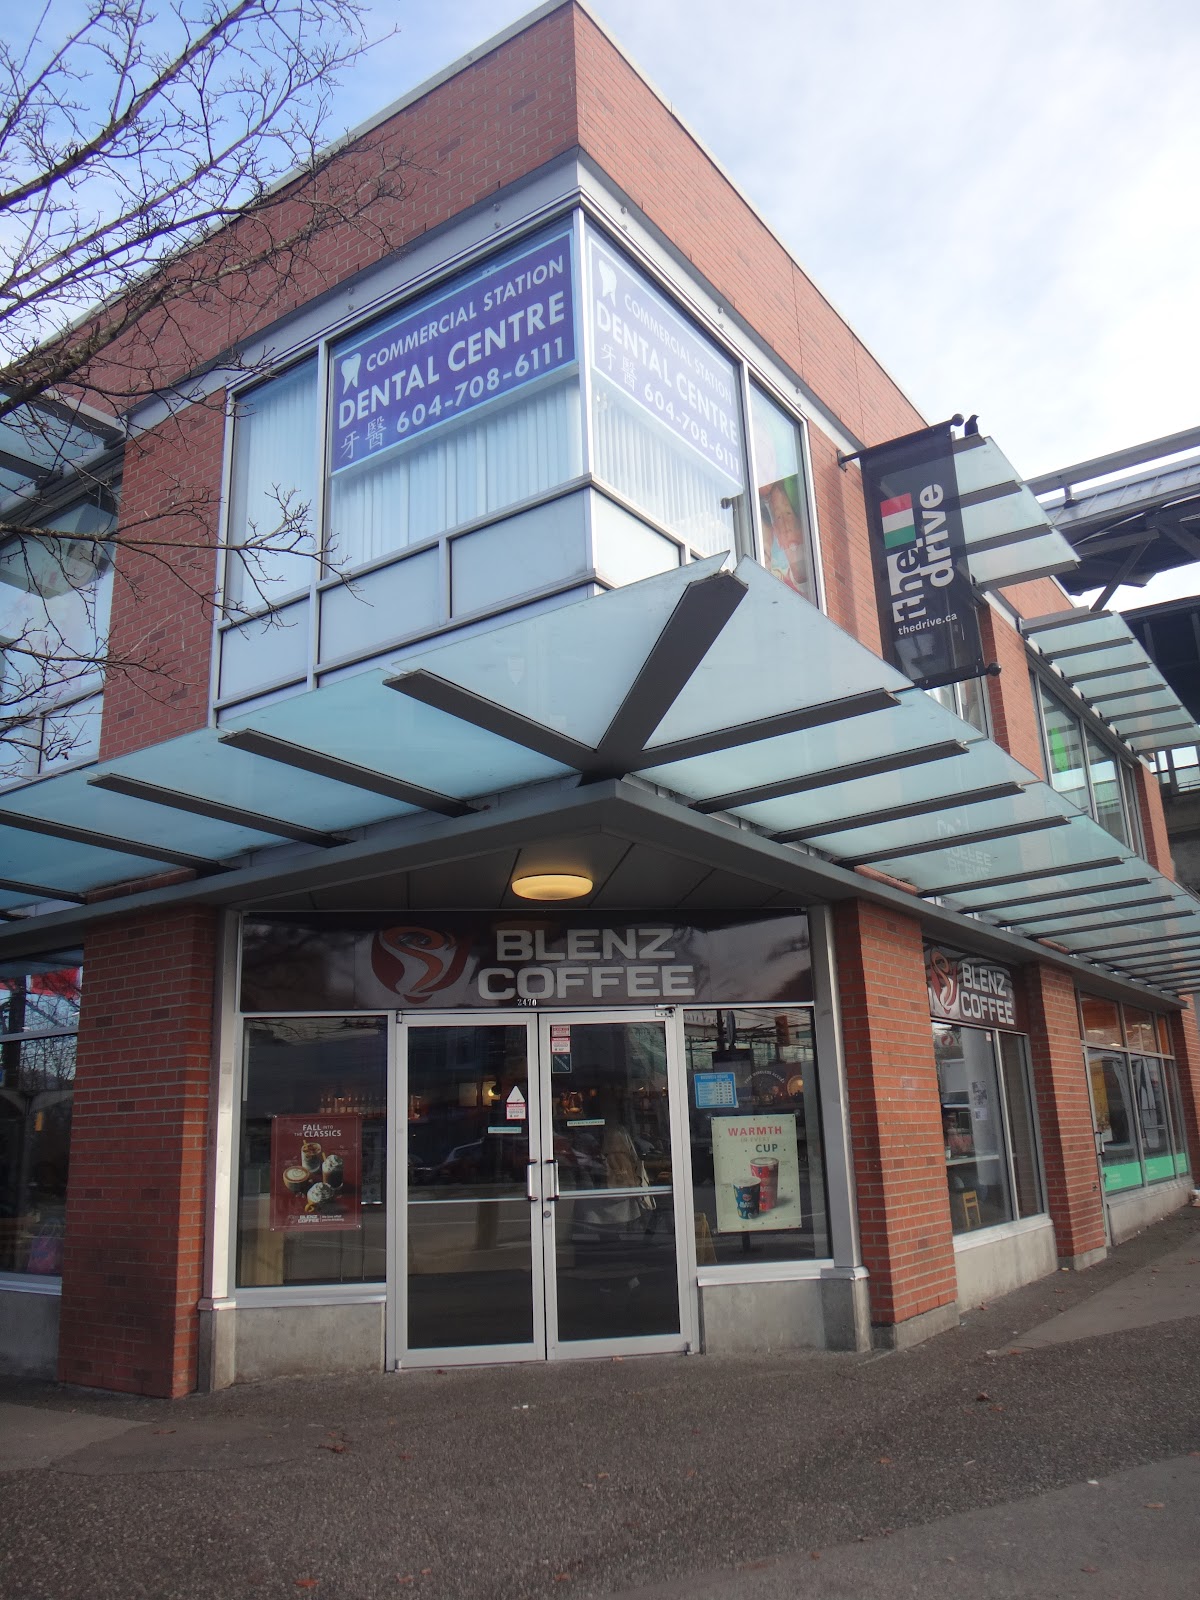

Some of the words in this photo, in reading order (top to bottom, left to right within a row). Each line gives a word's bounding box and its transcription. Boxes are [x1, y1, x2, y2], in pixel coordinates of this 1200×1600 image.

[366, 301, 477, 372] COMMERCIAL
[483, 255, 564, 312] STATION
[338, 355, 440, 430] DENTAL
[447, 290, 565, 372] CENTRE
[624, 293, 692, 367] COMMERCIAL
[694, 359, 732, 406] STATION
[396, 336, 563, 433] 604-708-6111
[596, 300, 672, 388] DENTAL
[676, 372, 738, 446] CENTRE
[644, 383, 740, 475] 604-708-6111
[916, 483, 955, 588] drive
[898, 613, 958, 636] thedrive.ca
[496, 928, 676, 962] BLENZ
[477, 965, 696, 1000] COFFEE
[962, 962, 1007, 997] BLENZ
[517, 998, 537, 1007] 2470
[961, 991, 1015, 1025] COFFEE
[303, 1129, 342, 1138] CLASSICS
[728, 1126, 782, 1137] WARMTH
[755, 1143, 779, 1153] CUP
